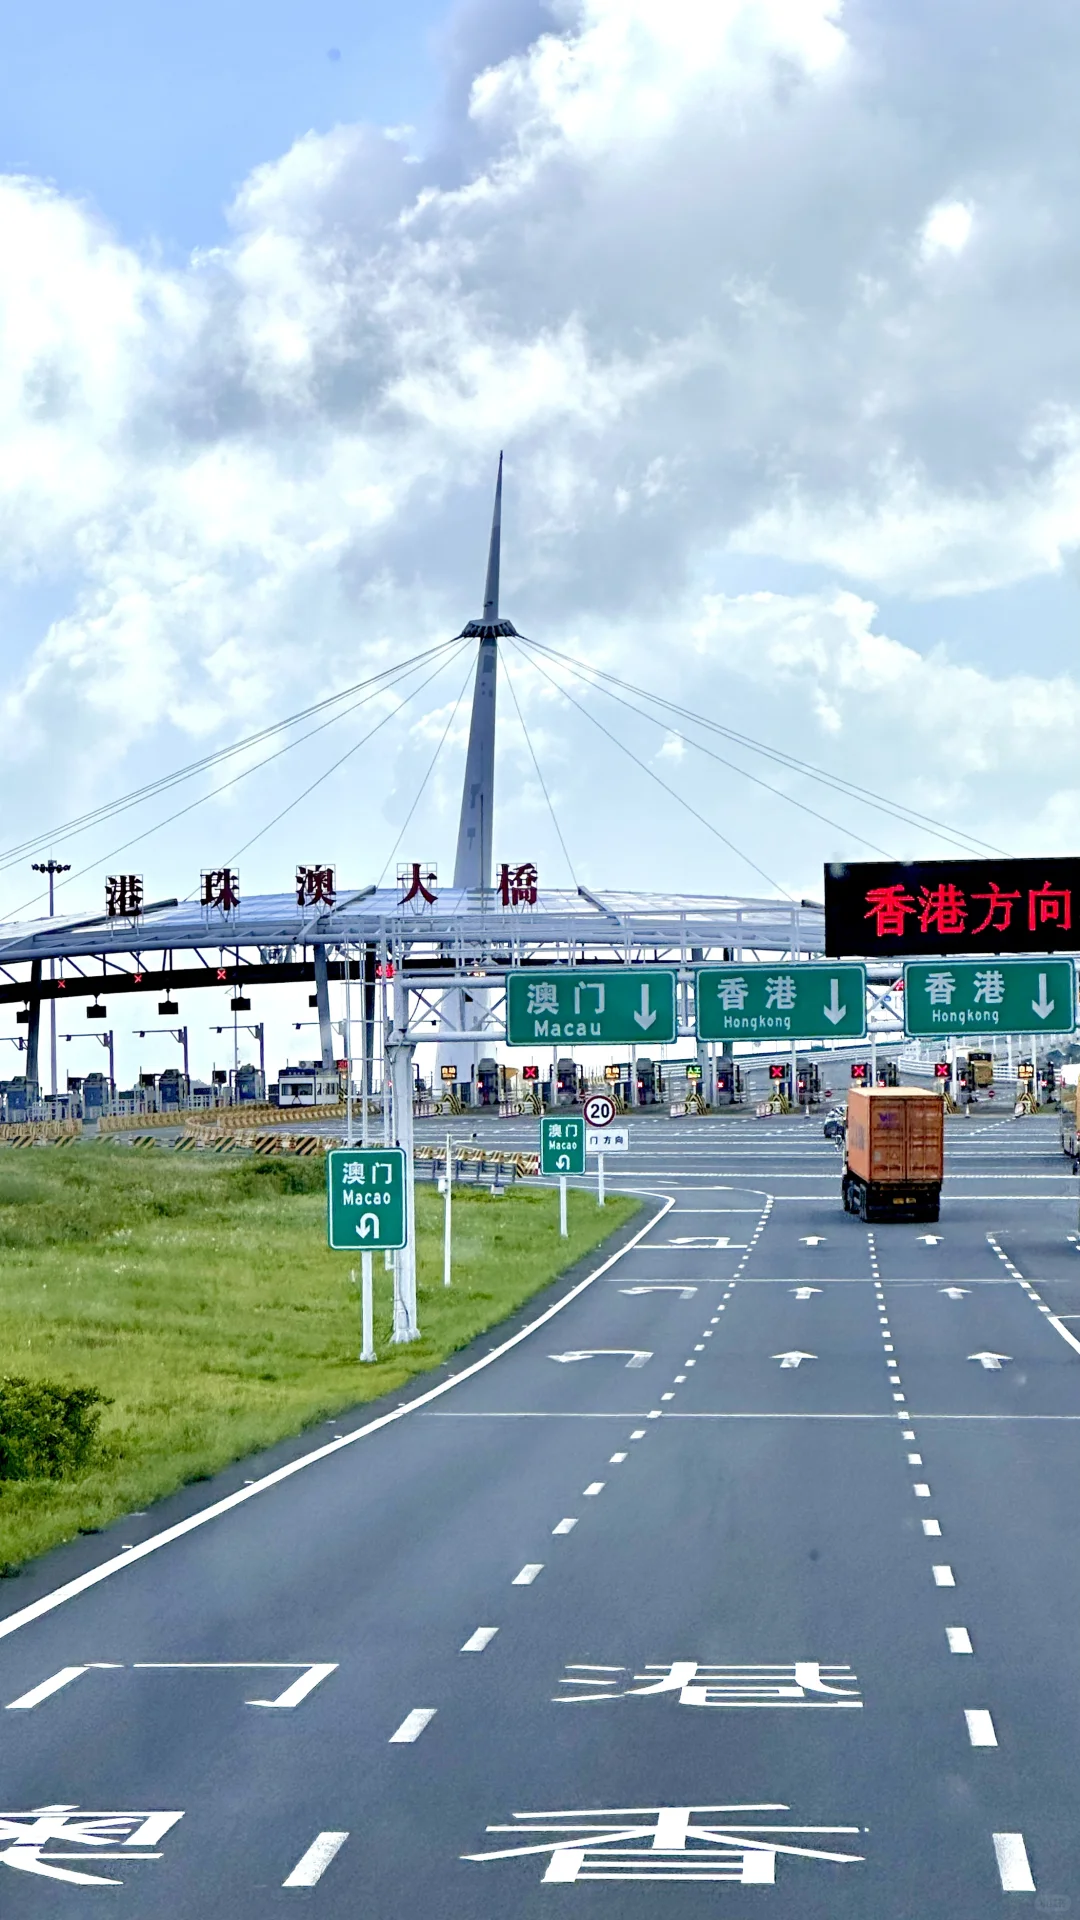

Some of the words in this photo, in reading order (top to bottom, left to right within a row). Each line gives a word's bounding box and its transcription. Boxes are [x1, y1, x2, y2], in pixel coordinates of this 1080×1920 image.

[105, 863, 539, 918] 港珠澳大橋
[864, 881, 1072, 937] 香港方向
[717, 976, 797, 1011] 香港
[924, 970, 1006, 1005] 香港
[527, 981, 605, 1015] 澳门
[724, 1015, 791, 1031] Hongkong
[932, 1009, 1000, 1026] Hongkong
[534, 1020, 602, 1037] Macau
[590, 1104, 610, 1119] 20
[548, 1124, 578, 1138] 澳门
[548, 1140, 578, 1151] Macao
[342, 1162, 393, 1185] 澳门
[342, 1189, 391, 1206] Macao
